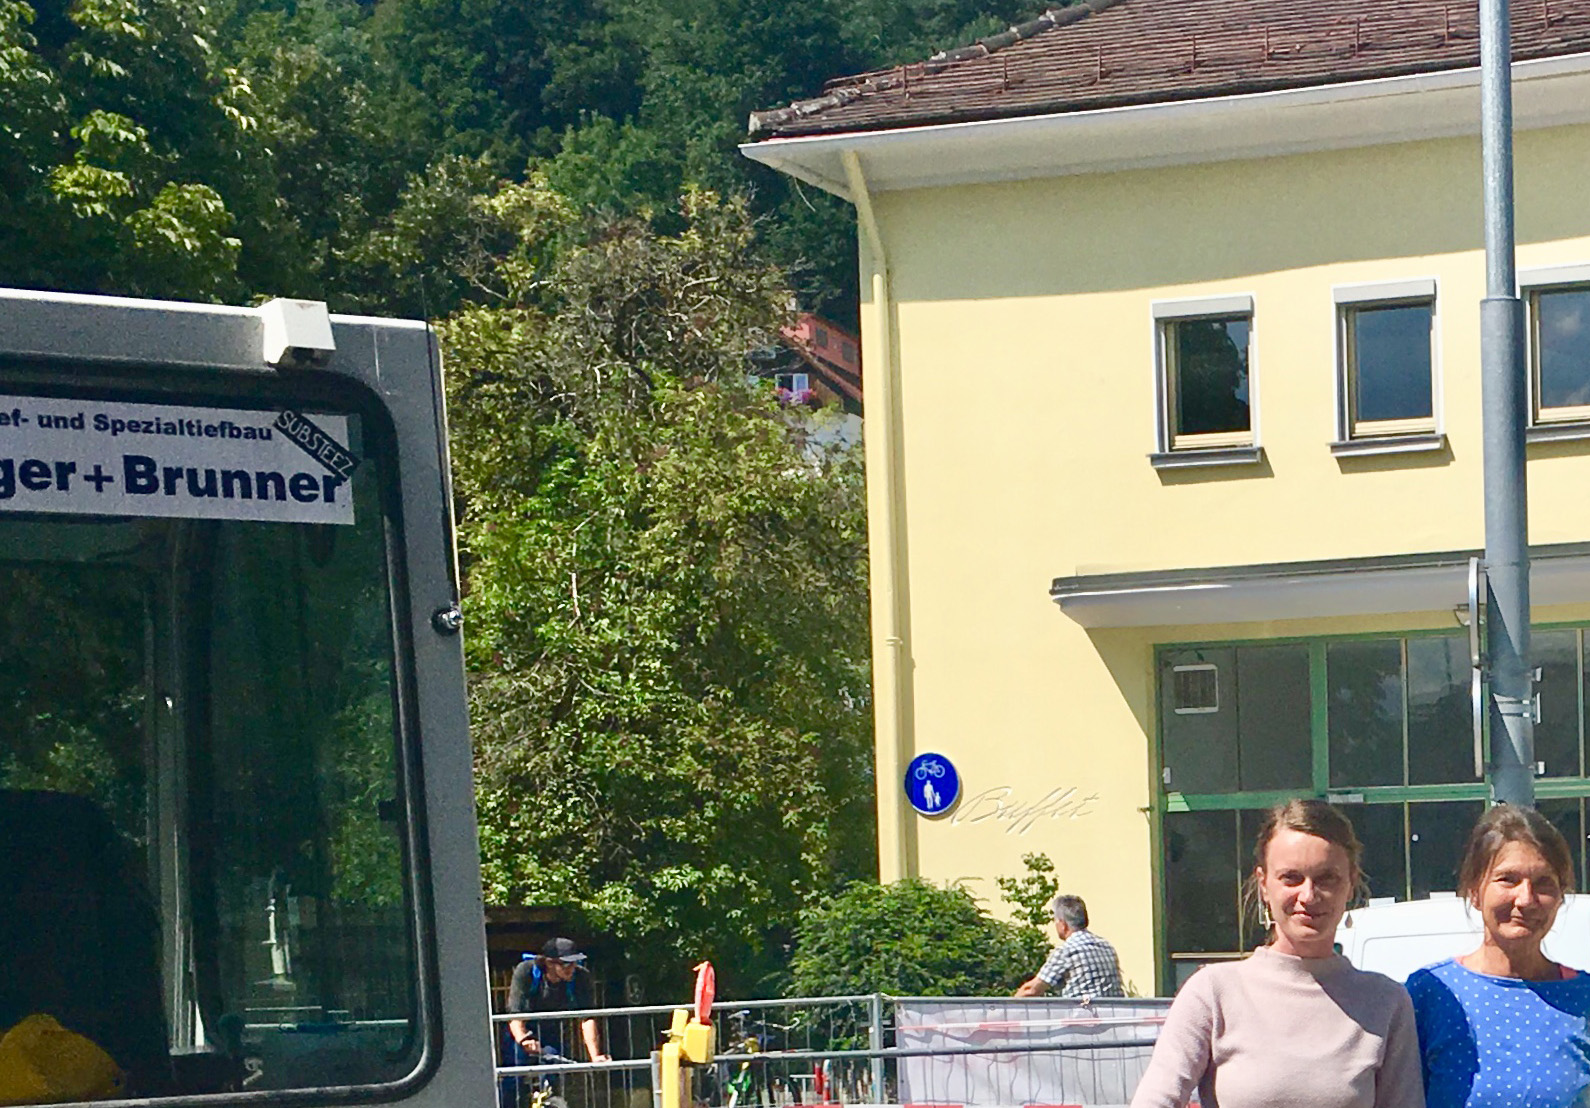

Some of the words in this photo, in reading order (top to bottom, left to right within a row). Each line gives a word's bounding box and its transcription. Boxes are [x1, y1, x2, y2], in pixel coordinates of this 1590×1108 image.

[37, 413, 84, 430] und
[93, 413, 273, 441] Spezialtiefbau
[275, 410, 354, 473] SUBSTEEZ
[950, 785, 1100, 834] Buffet
